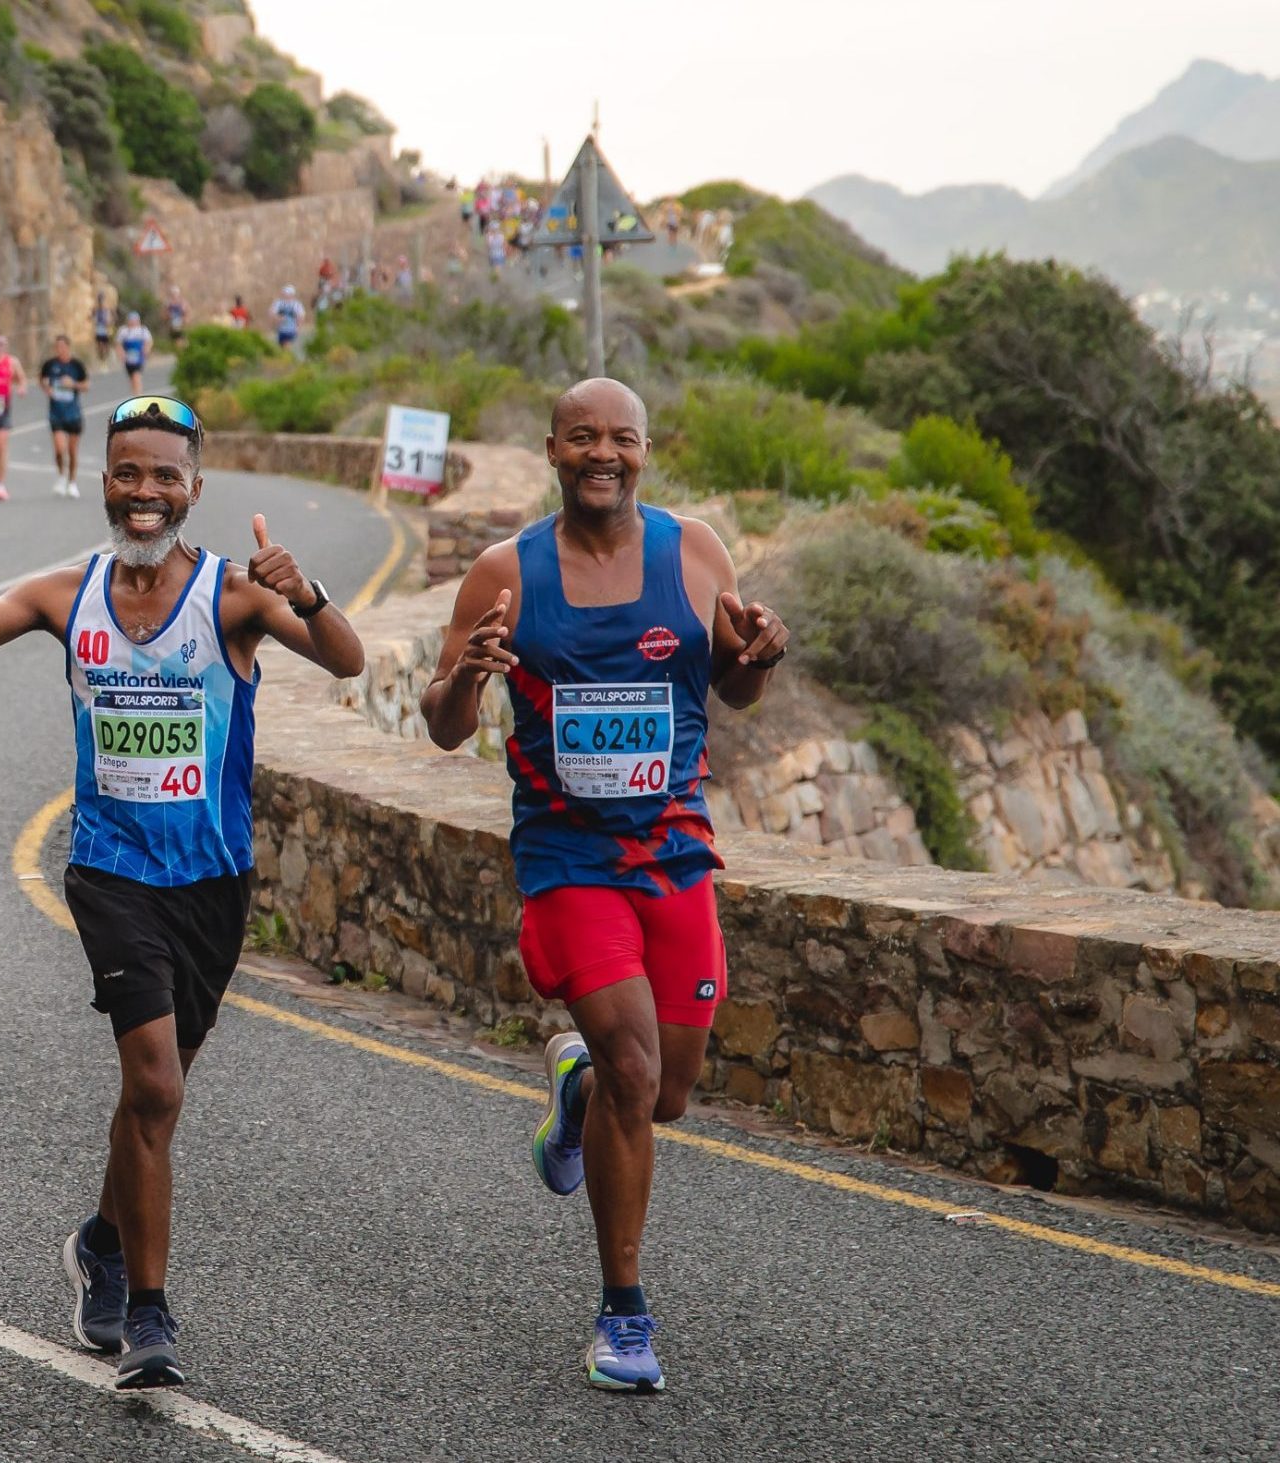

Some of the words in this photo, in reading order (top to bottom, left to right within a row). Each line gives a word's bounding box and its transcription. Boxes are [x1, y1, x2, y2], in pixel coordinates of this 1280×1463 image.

[387, 446, 424, 474] 31
[76, 630, 110, 665] 40
[638, 639, 680, 649] LEGENDS
[85, 671, 204, 689] Bedfordview
[114, 694, 178, 706] TOTALSPORTS
[580, 691, 647, 702] TOTALSPORTS
[100, 720, 198, 755] D29053
[562, 718, 580, 750] C
[592, 717, 657, 751] 6249
[98, 755, 128, 768] Tshepo
[558, 755, 612, 766] Kgosietsile
[160, 764, 202, 797] 40
[628, 759, 665, 792] 40
